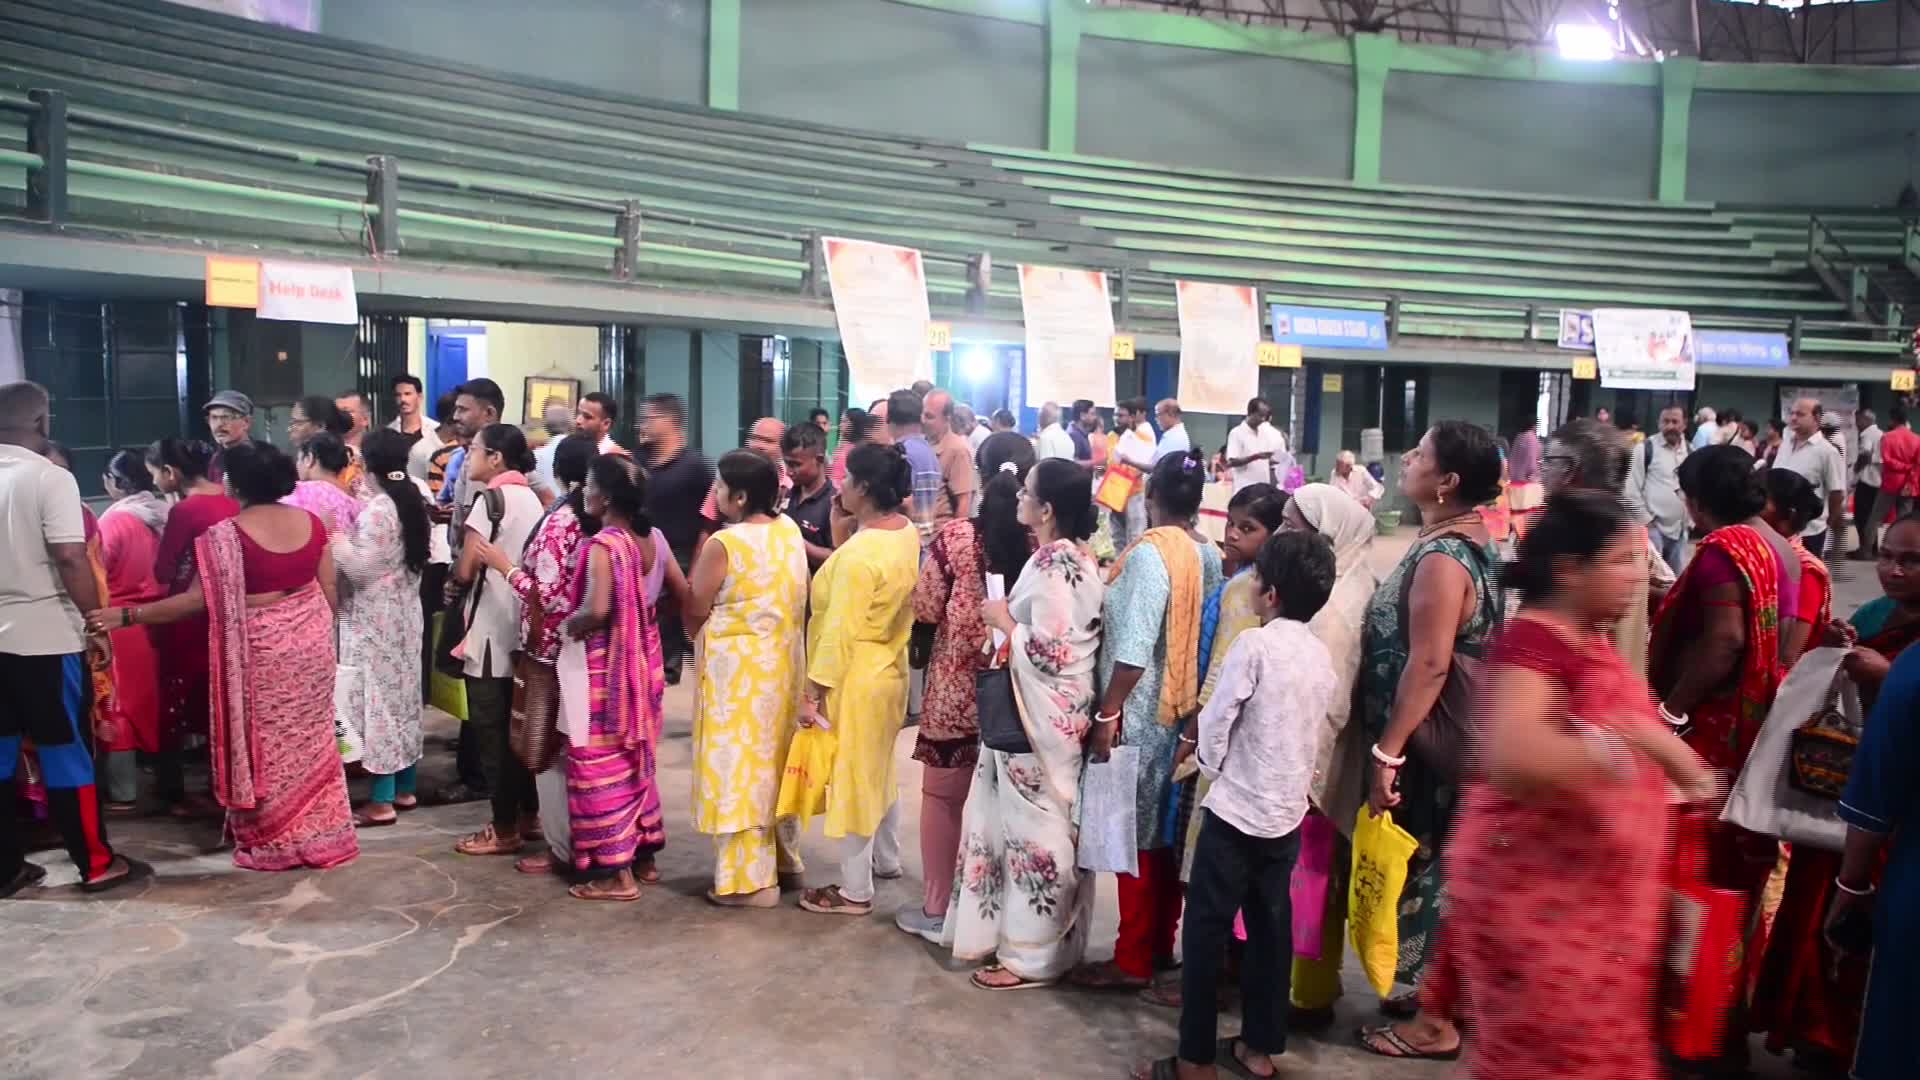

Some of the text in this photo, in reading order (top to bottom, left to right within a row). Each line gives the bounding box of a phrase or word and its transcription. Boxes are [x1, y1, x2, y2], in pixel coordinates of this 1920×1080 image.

[269, 280, 305, 299] Help
[310, 284, 344, 302] Desk
[928, 328, 946, 346] 28
[1114, 341, 1130, 357] 27
[1259, 350, 1277, 364] 26
[1895, 375, 1911, 387] 24
